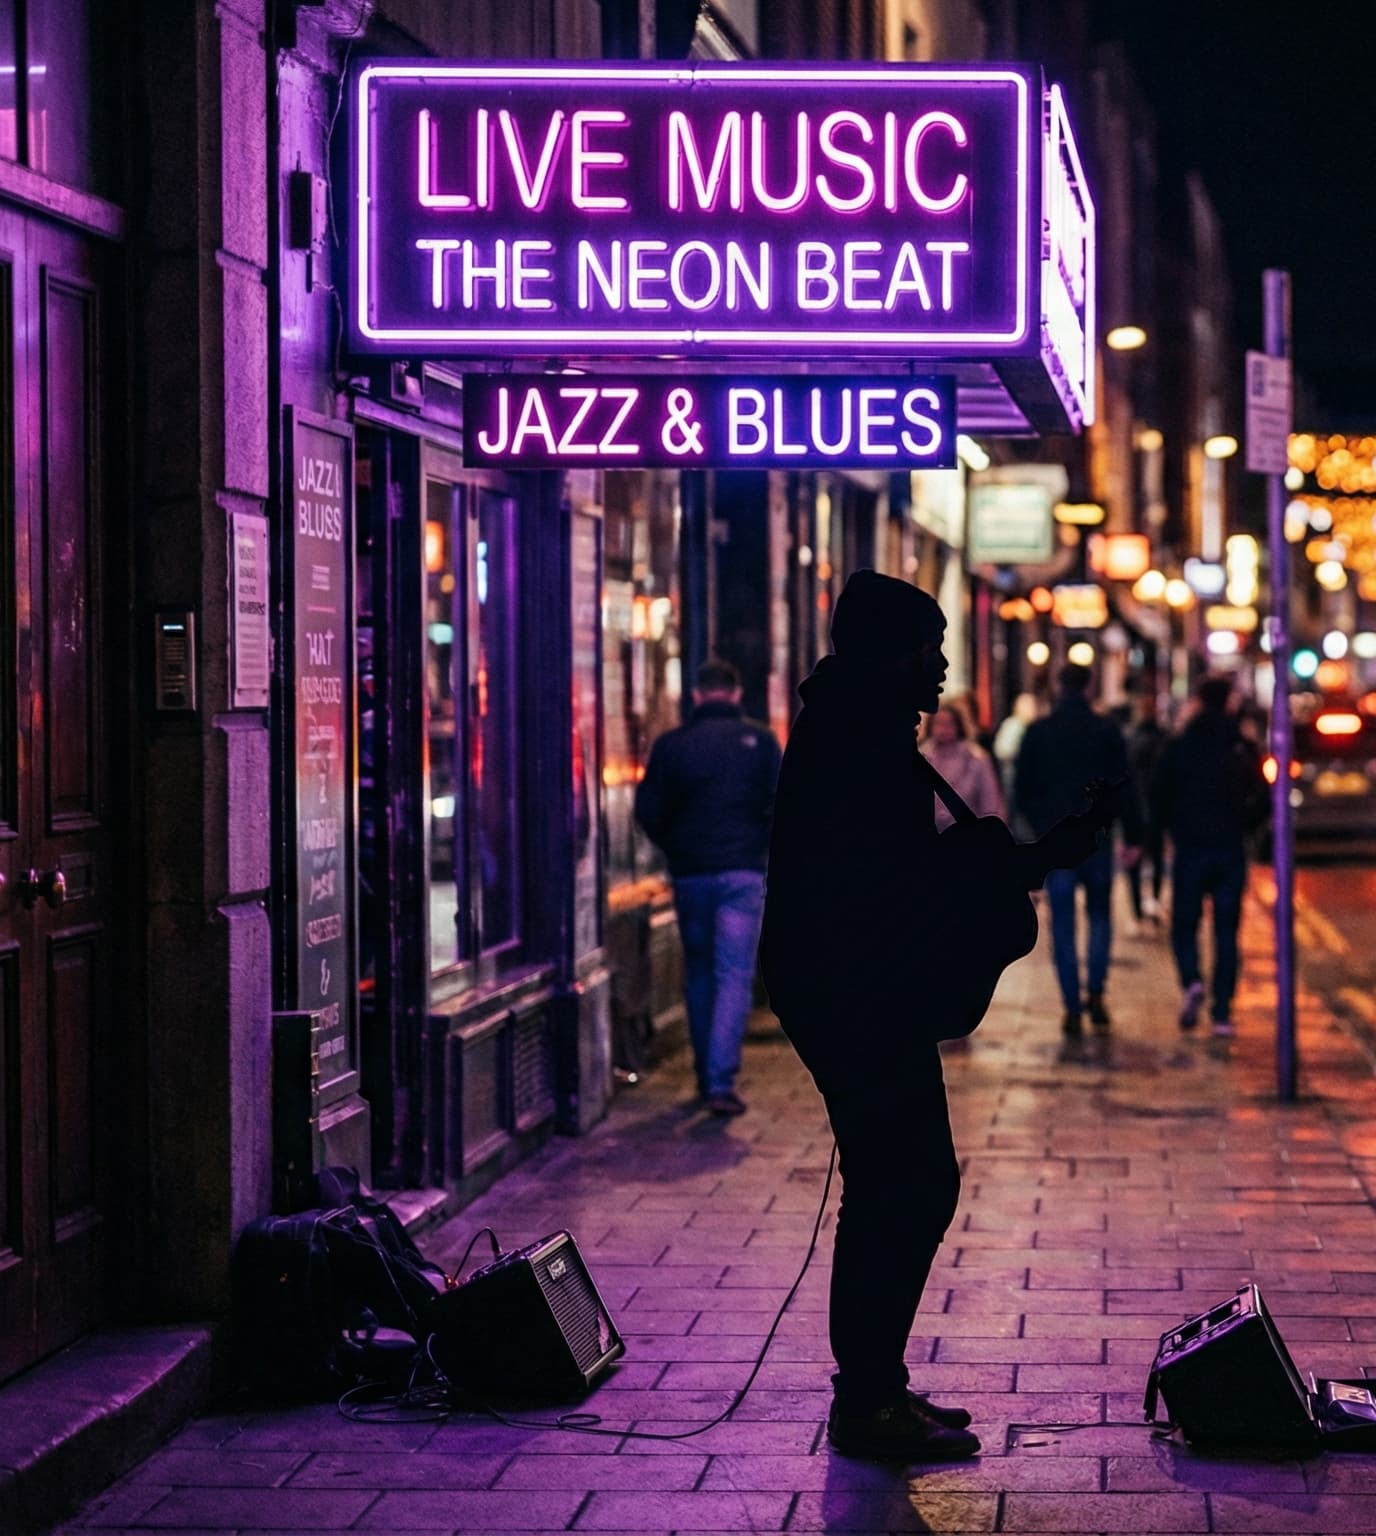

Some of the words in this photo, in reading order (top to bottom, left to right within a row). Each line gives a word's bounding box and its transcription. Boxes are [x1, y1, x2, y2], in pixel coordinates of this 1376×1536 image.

[417, 109, 628, 210] LIVE
[668, 109, 968, 212] MUSIC
[416, 238, 554, 308] THE
[577, 240, 770, 309] NEON
[796, 241, 970, 310] BEAT
[477, 387, 640, 455] JAZZ
[661, 387, 704, 456] &
[728, 387, 943, 456] BLUES
